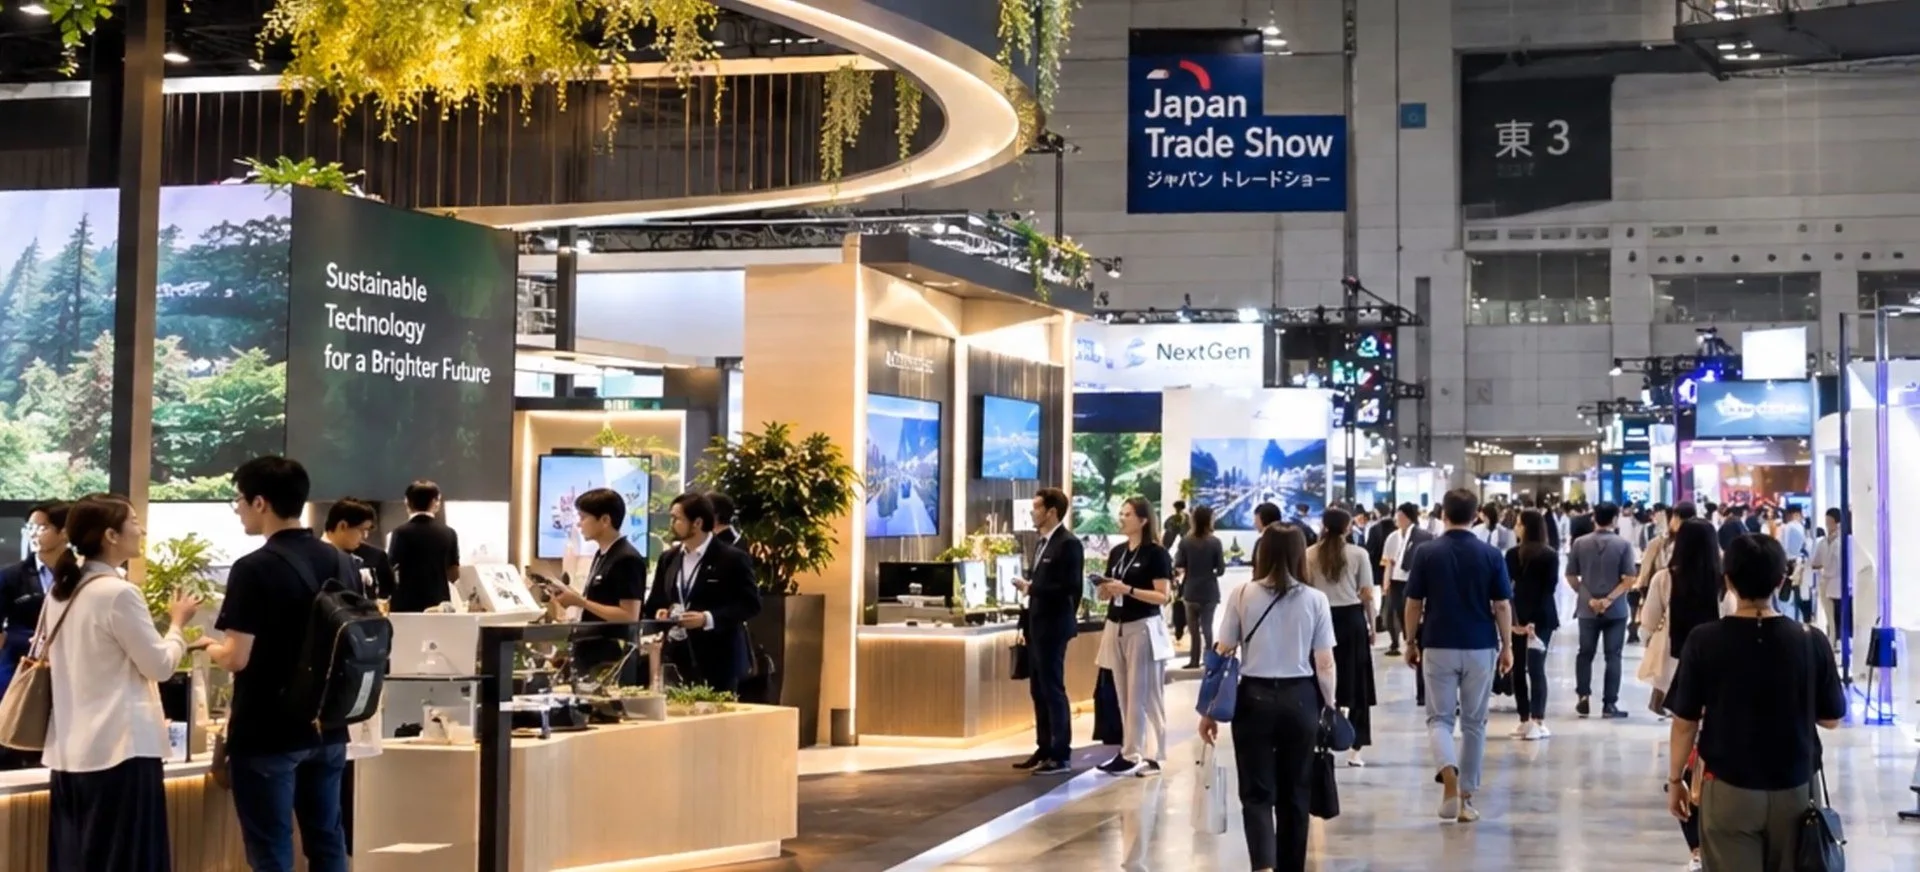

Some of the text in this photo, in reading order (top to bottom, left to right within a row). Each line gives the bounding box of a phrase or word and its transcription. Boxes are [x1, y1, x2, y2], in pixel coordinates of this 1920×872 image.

[1144, 88, 1247, 126] Japan
[1144, 126, 1334, 158] Trade Show
[1494, 119, 1570, 158] 東 3
[1222, 170, 1331, 188] トレードショー
[326, 262, 428, 302] Sustainable
[324, 303, 426, 345] Technology
[324, 343, 492, 384] for a Brighter Future
[1156, 341, 1251, 361] NextGen
